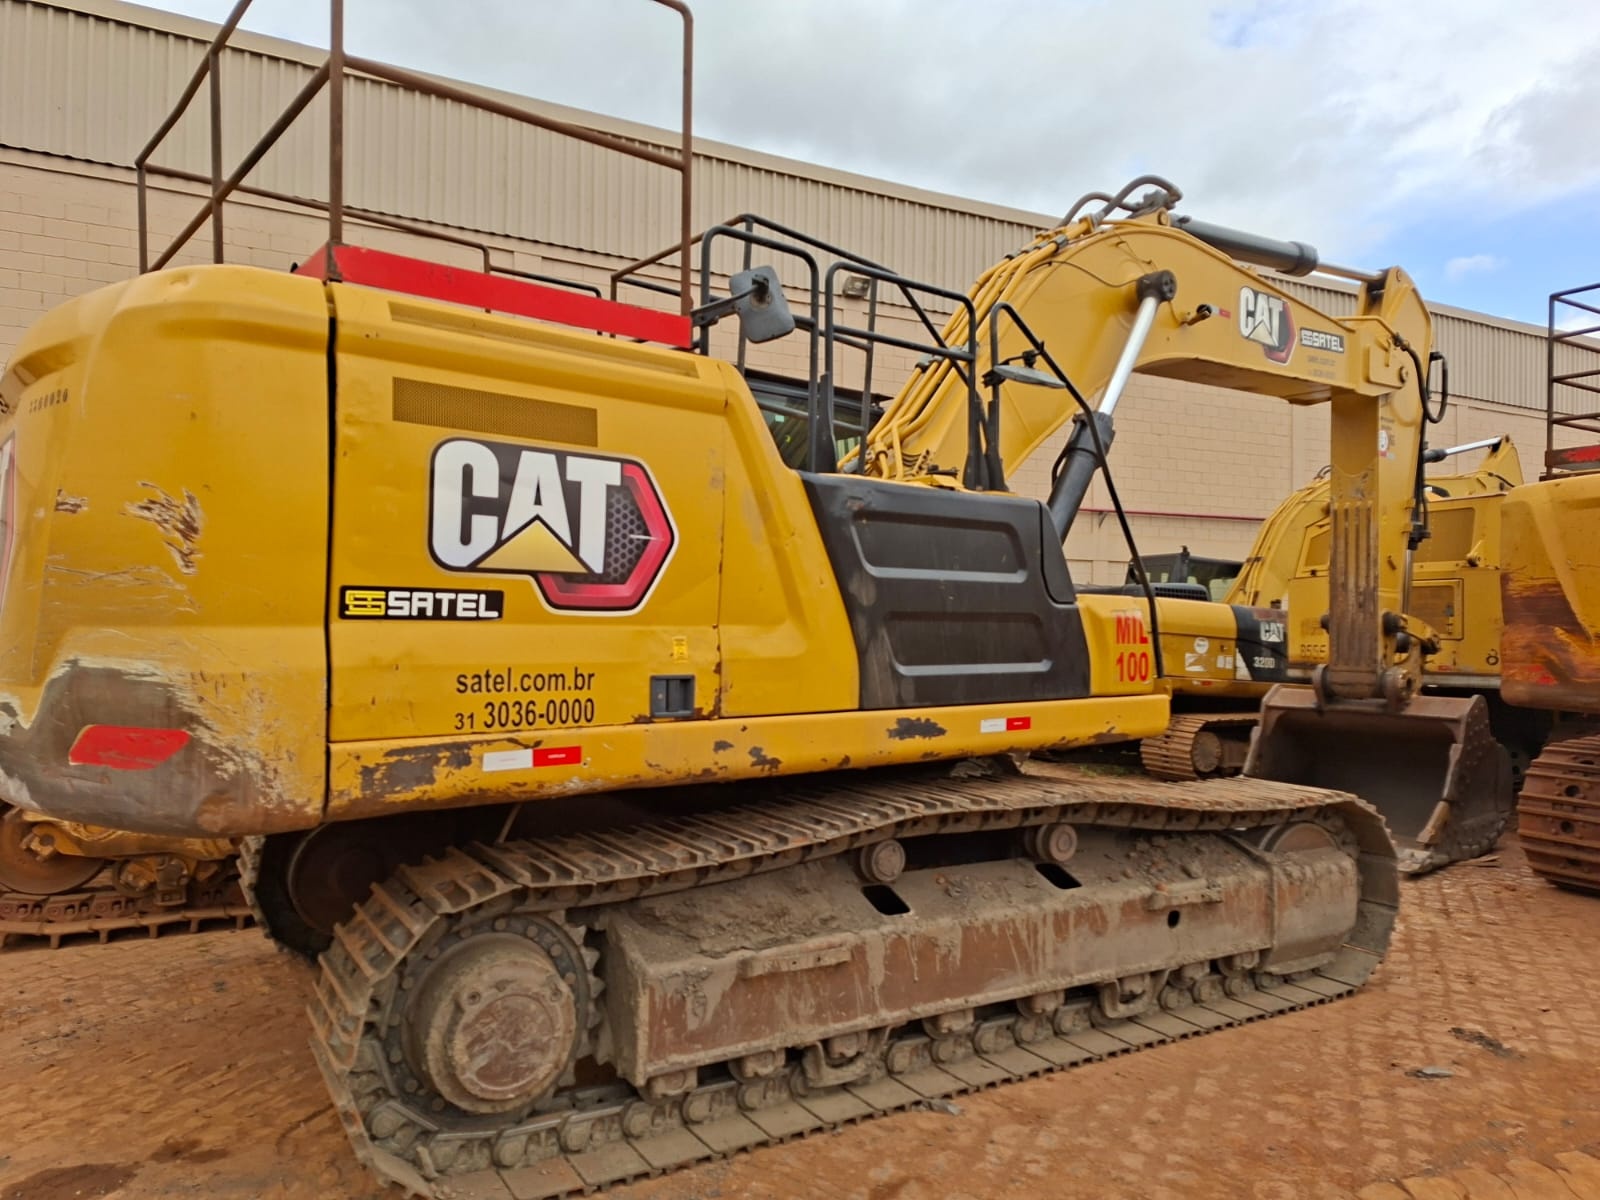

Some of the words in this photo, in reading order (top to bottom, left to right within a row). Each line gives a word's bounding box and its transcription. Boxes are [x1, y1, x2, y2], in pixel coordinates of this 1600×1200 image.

[1240, 286, 1284, 346] CAT
[1312, 332, 1344, 352] SATEL
[432, 440, 622, 574] CAT
[387, 591, 499, 618] SATEL
[1116, 614, 1148, 644] MIL
[1260, 621, 1284, 642] CAT
[456, 666, 595, 693] satel.com.br
[1116, 652, 1149, 682] 100
[454, 712, 475, 730] 31
[484, 698, 595, 728] 3036-0000
